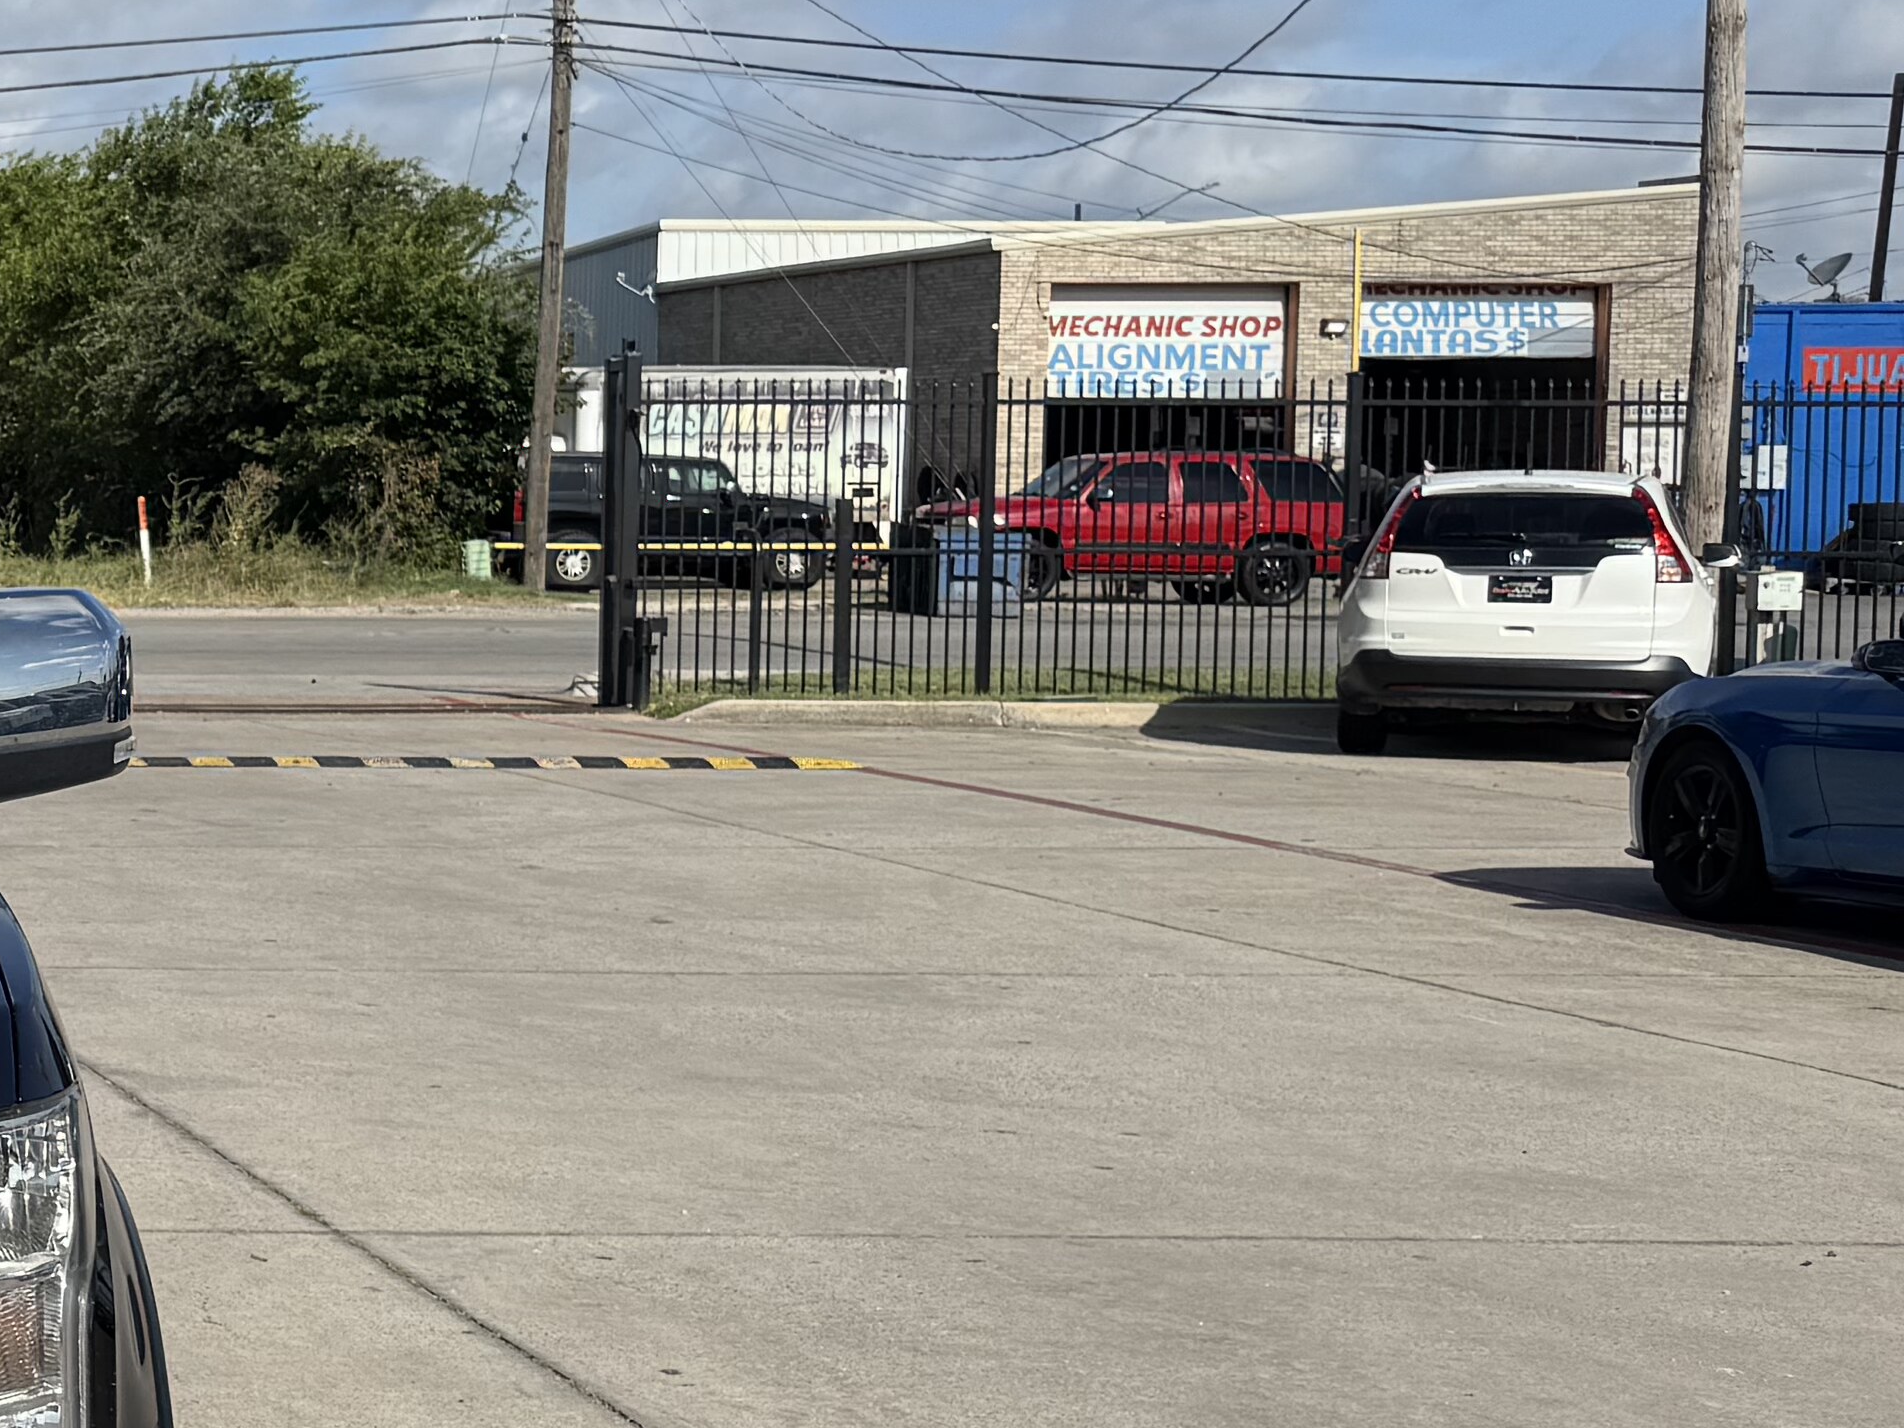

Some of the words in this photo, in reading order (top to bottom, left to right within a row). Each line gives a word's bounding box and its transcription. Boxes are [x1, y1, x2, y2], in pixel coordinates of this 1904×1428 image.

[1048, 315, 1193, 338] MECHANIC
[1200, 315, 1282, 338] SHOP
[1369, 301, 1559, 328] COMPUTER
[1506, 327, 1525, 354] $
[1047, 343, 1271, 370] ALIGNMENT
[1049, 371, 1165, 395] TIRES
